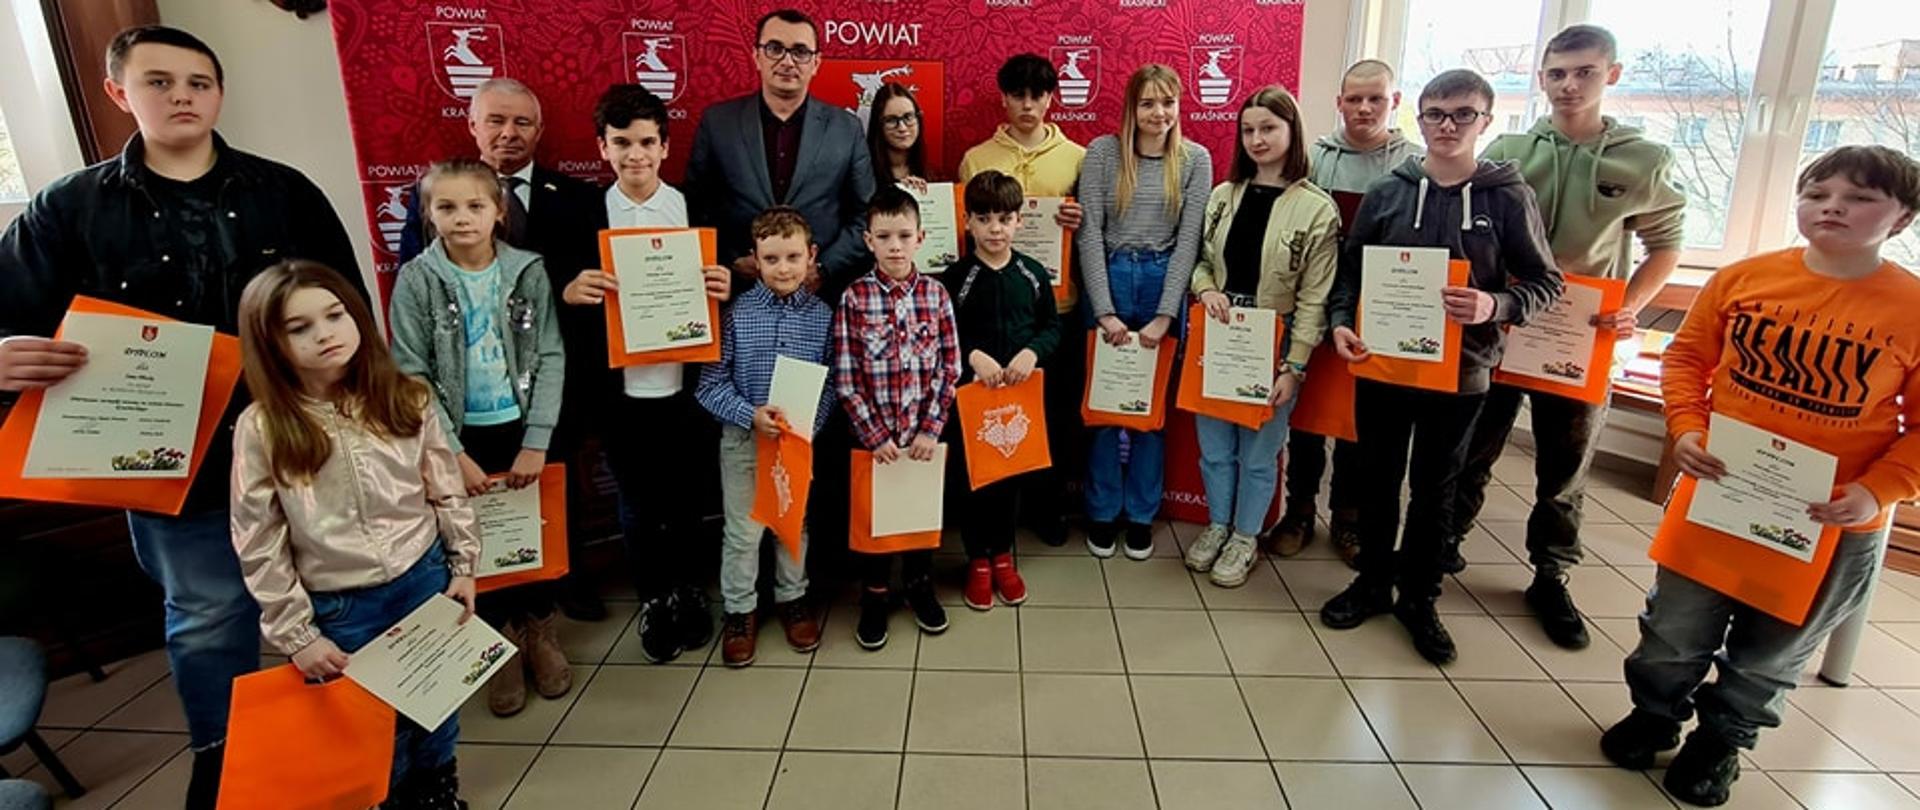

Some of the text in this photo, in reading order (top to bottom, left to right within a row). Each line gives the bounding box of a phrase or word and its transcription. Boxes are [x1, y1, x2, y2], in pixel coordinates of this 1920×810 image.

[435, 6, 487, 19] POWIAT
[631, 18, 673, 30] POWIAT
[824, 20, 922, 46] POWIAT
[1199, 33, 1234, 43] POWIAT
[1058, 35, 1092, 45] POWIAT
[367, 165, 421, 177] POWIAT
[558, 160, 602, 172] POWIAT
[1731, 313, 1882, 403] REALITY
